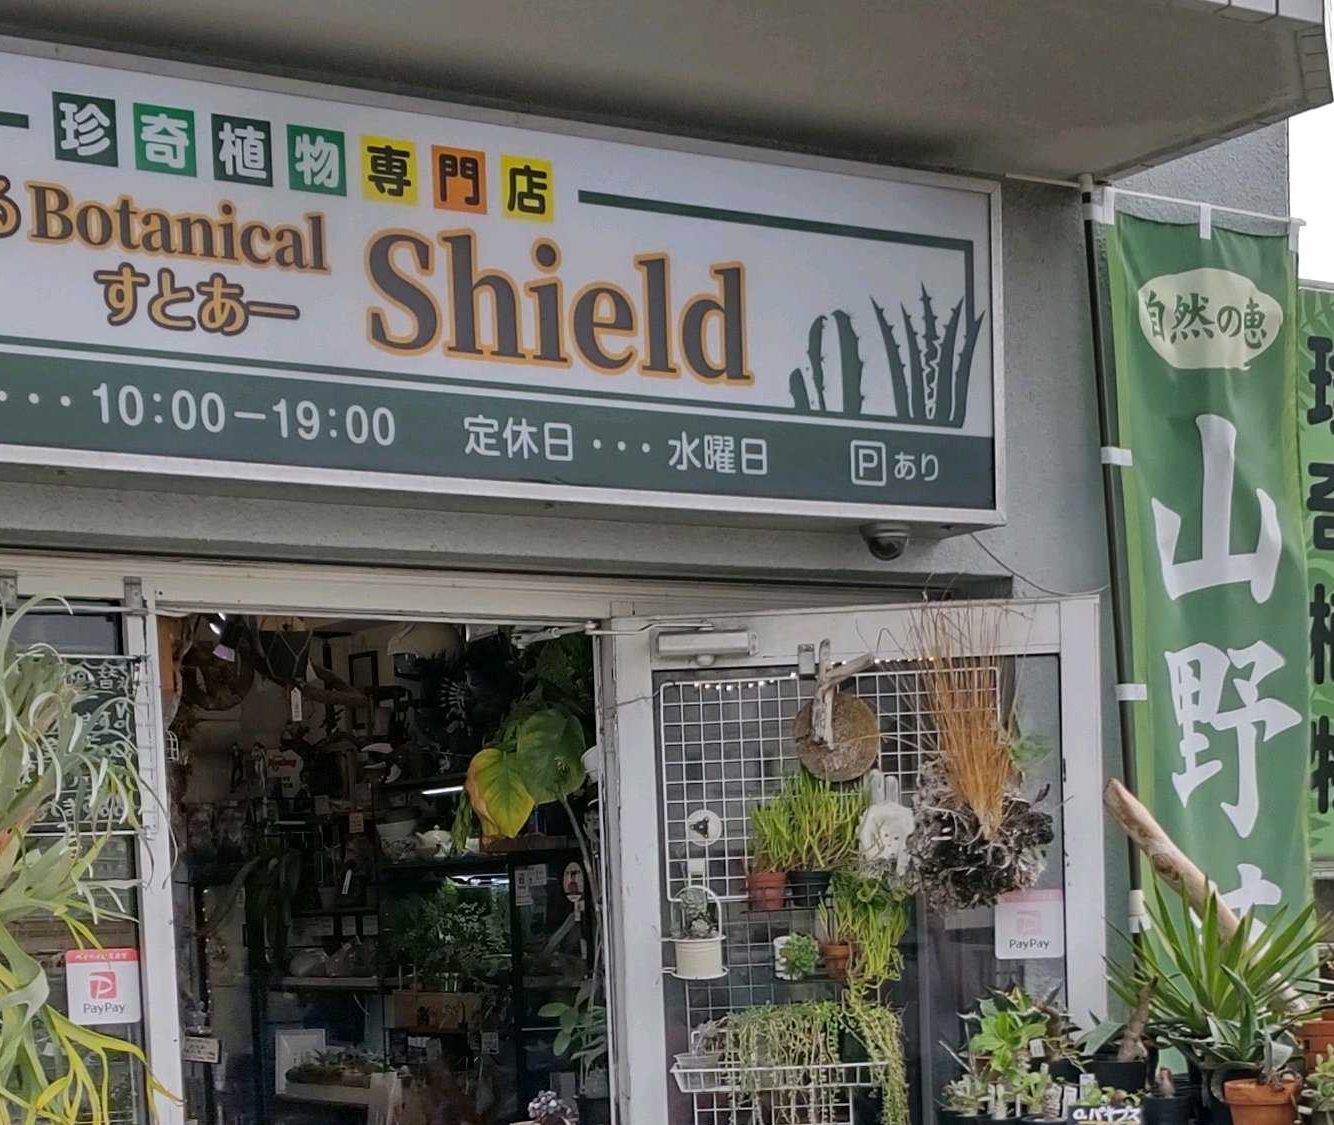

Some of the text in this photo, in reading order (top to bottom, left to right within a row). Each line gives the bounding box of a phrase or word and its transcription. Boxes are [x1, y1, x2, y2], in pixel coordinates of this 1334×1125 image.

[57, 97, 550, 218] 珍奇植物専門店
[27, 179, 332, 278] Botanical
[94, 262, 301, 338] すとあー
[363, 223, 756, 388] Shield
[1143, 290, 1267, 350] 自然の恵
[1150, 413, 1303, 960] 山野
[1009, 938, 1050, 950] PayPay
[83, 1001, 126, 1016] PayPay
